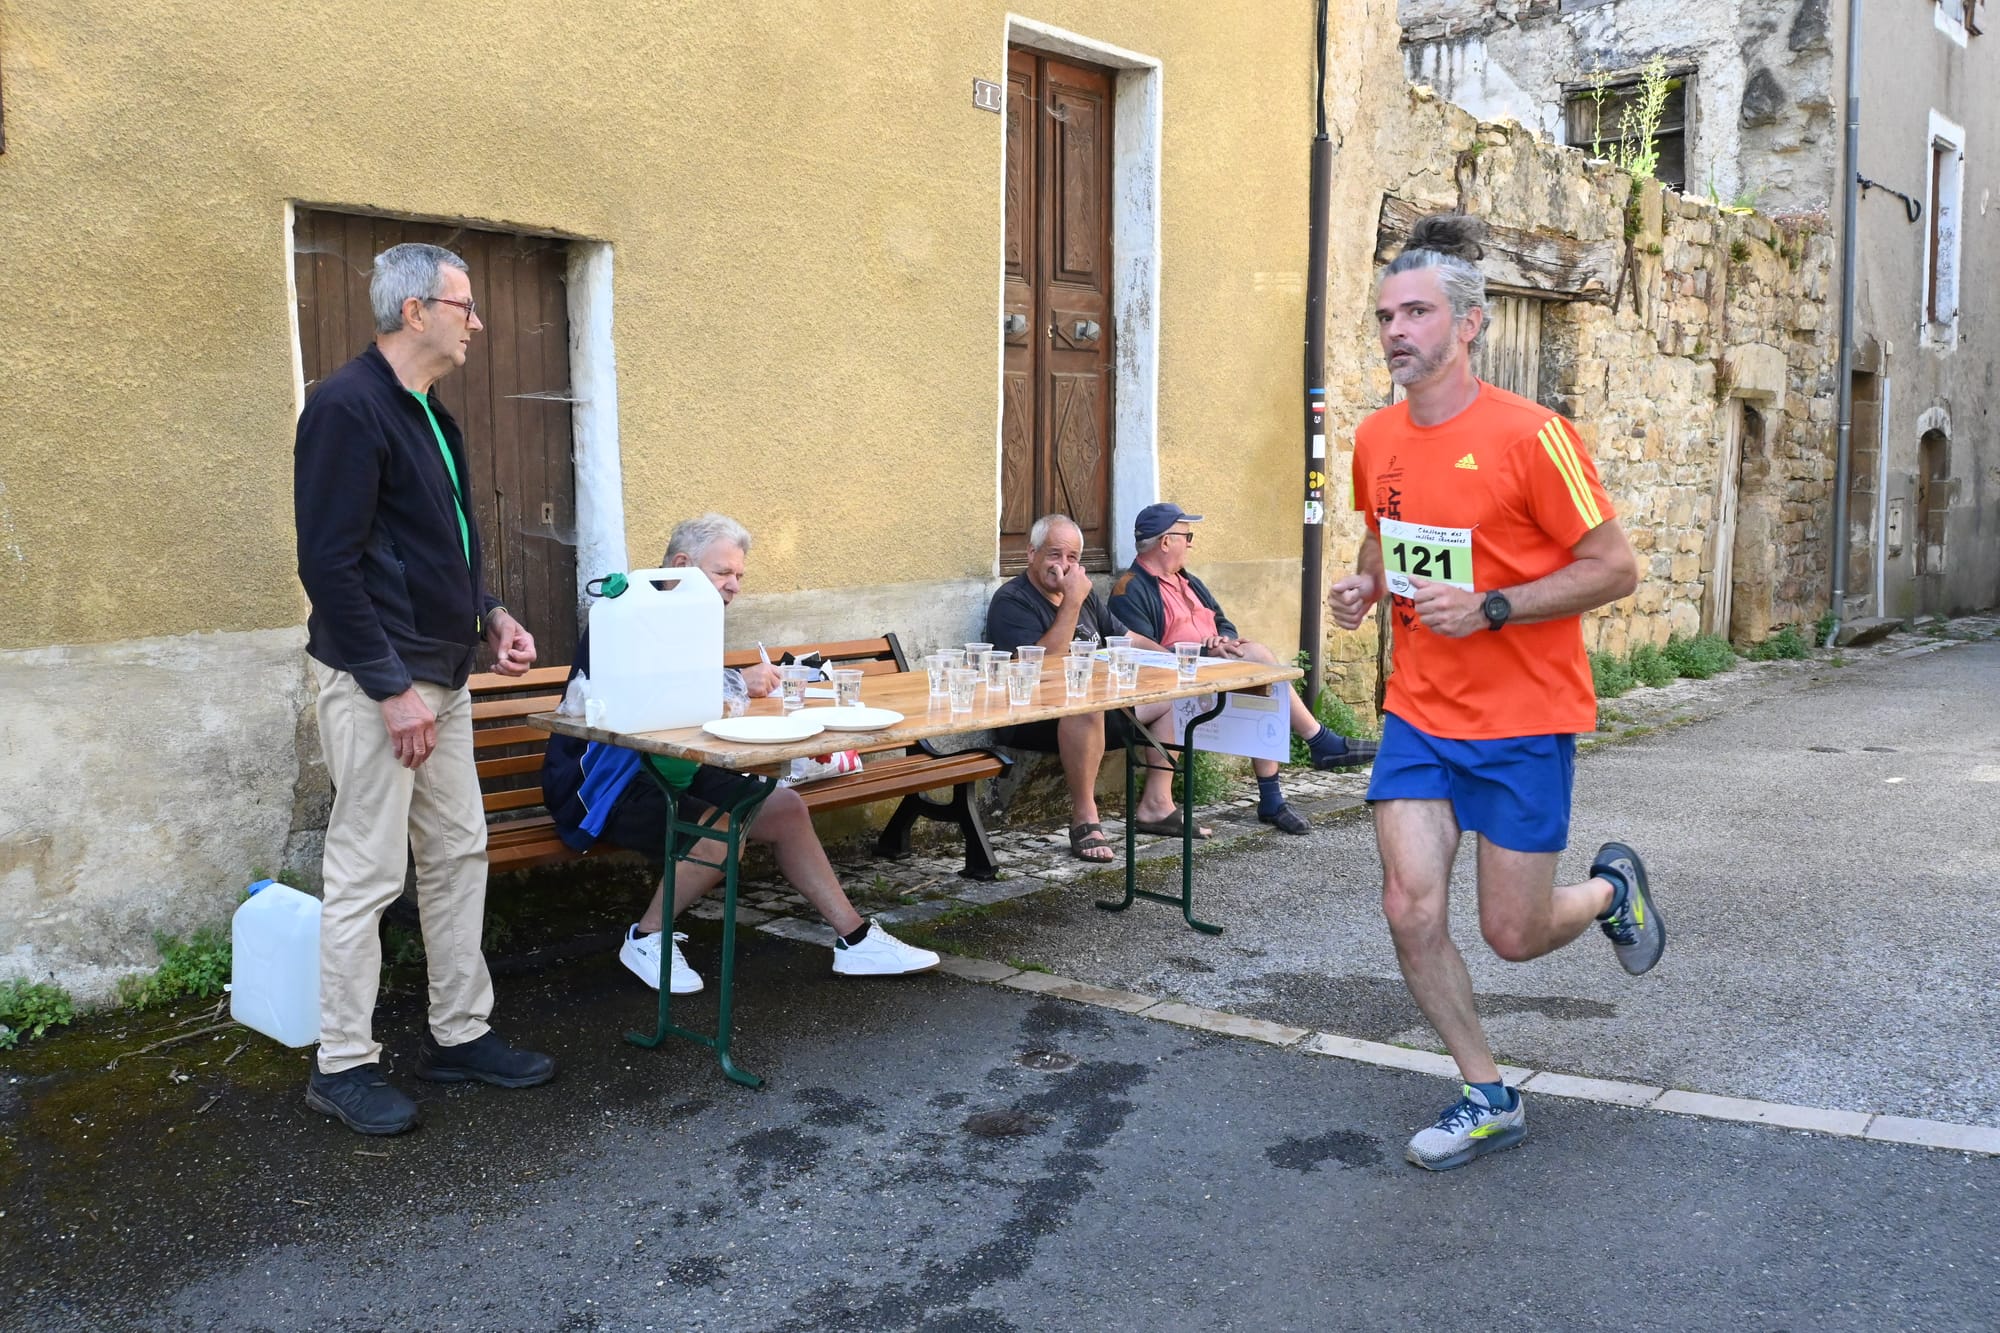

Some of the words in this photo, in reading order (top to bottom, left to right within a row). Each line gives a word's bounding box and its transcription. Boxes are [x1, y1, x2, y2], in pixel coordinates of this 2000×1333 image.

[985, 86, 992, 106] 1
[1417, 527, 1447, 538] Challenge
[1393, 542, 1452, 580] 121
